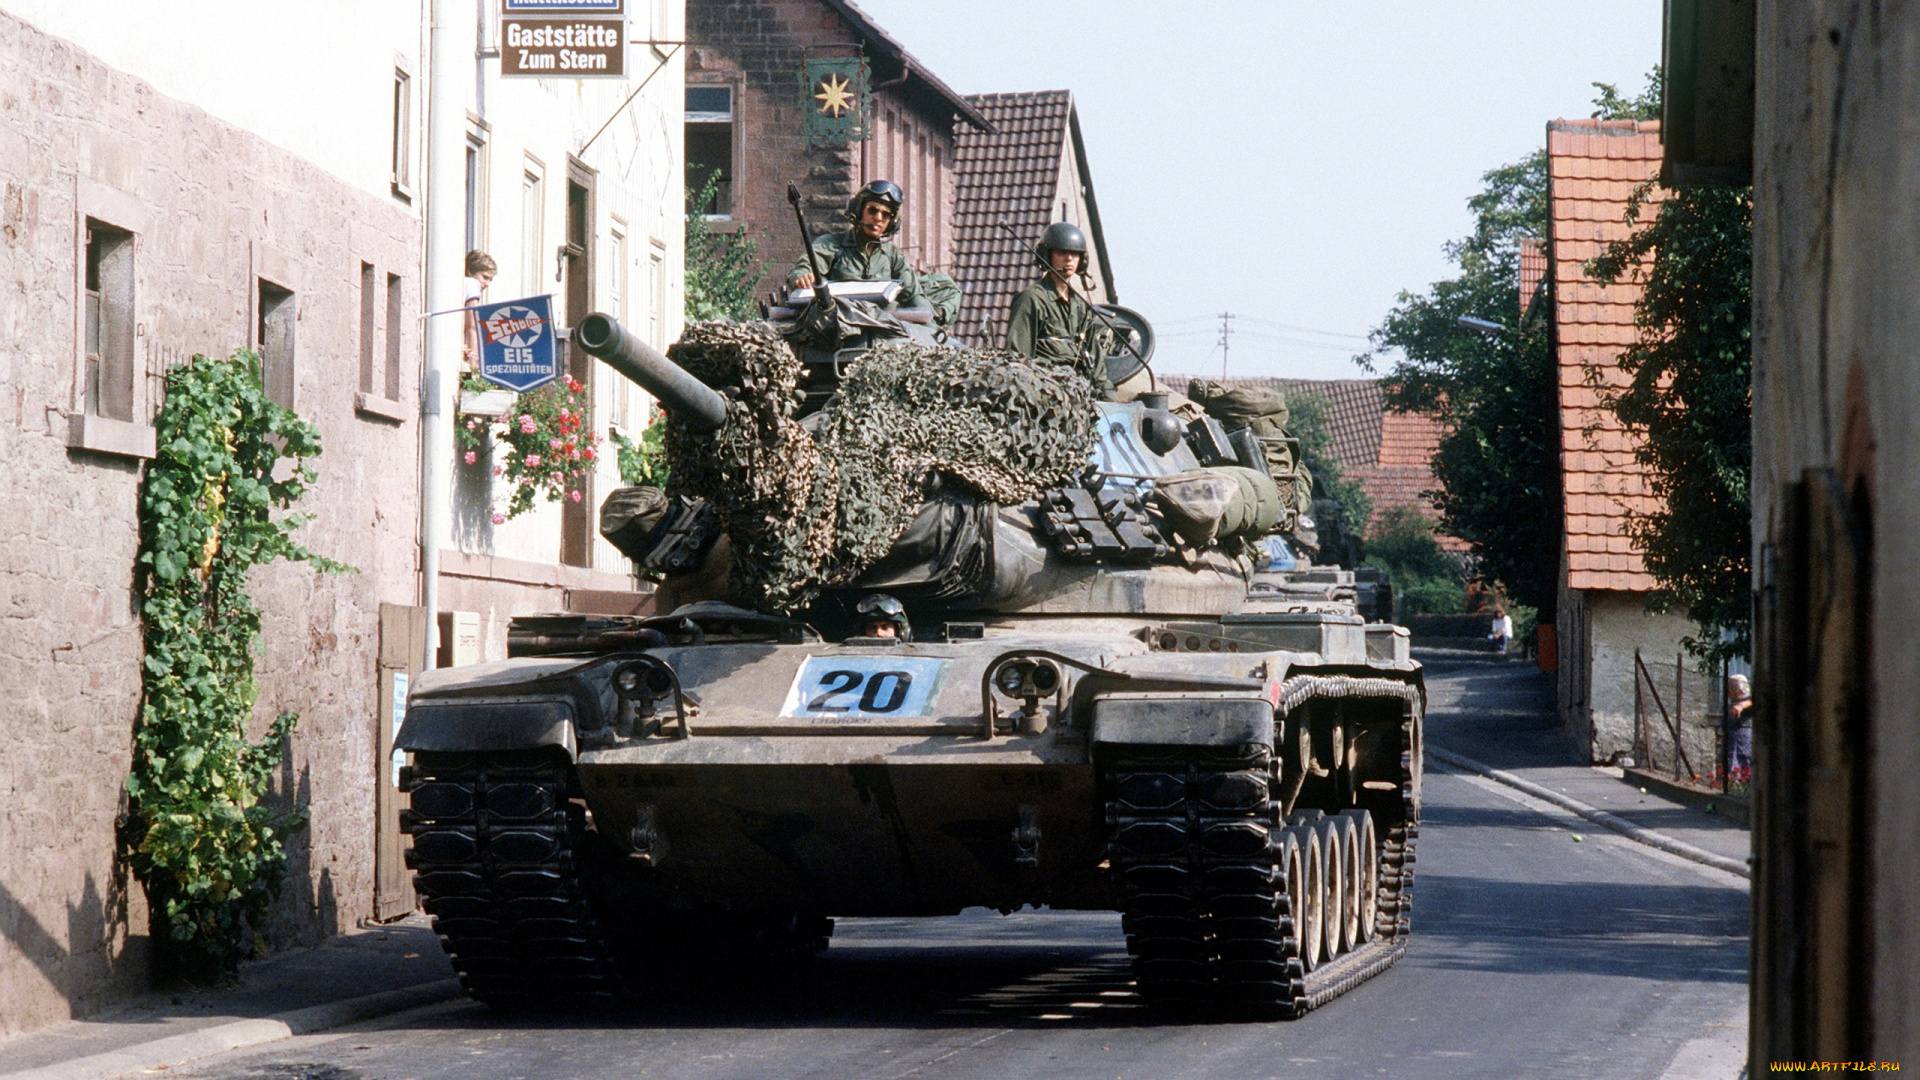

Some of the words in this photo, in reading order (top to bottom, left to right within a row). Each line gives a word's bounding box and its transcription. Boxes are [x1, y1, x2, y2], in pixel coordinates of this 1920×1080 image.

[507, 23, 617, 47] Gaststätte
[518, 50, 555, 69] Zum
[559, 50, 607, 69] Stern
[504, 348, 533, 363] EIS
[485, 363, 552, 374] SPEZIALITÄTEN
[806, 669, 913, 713] 20
